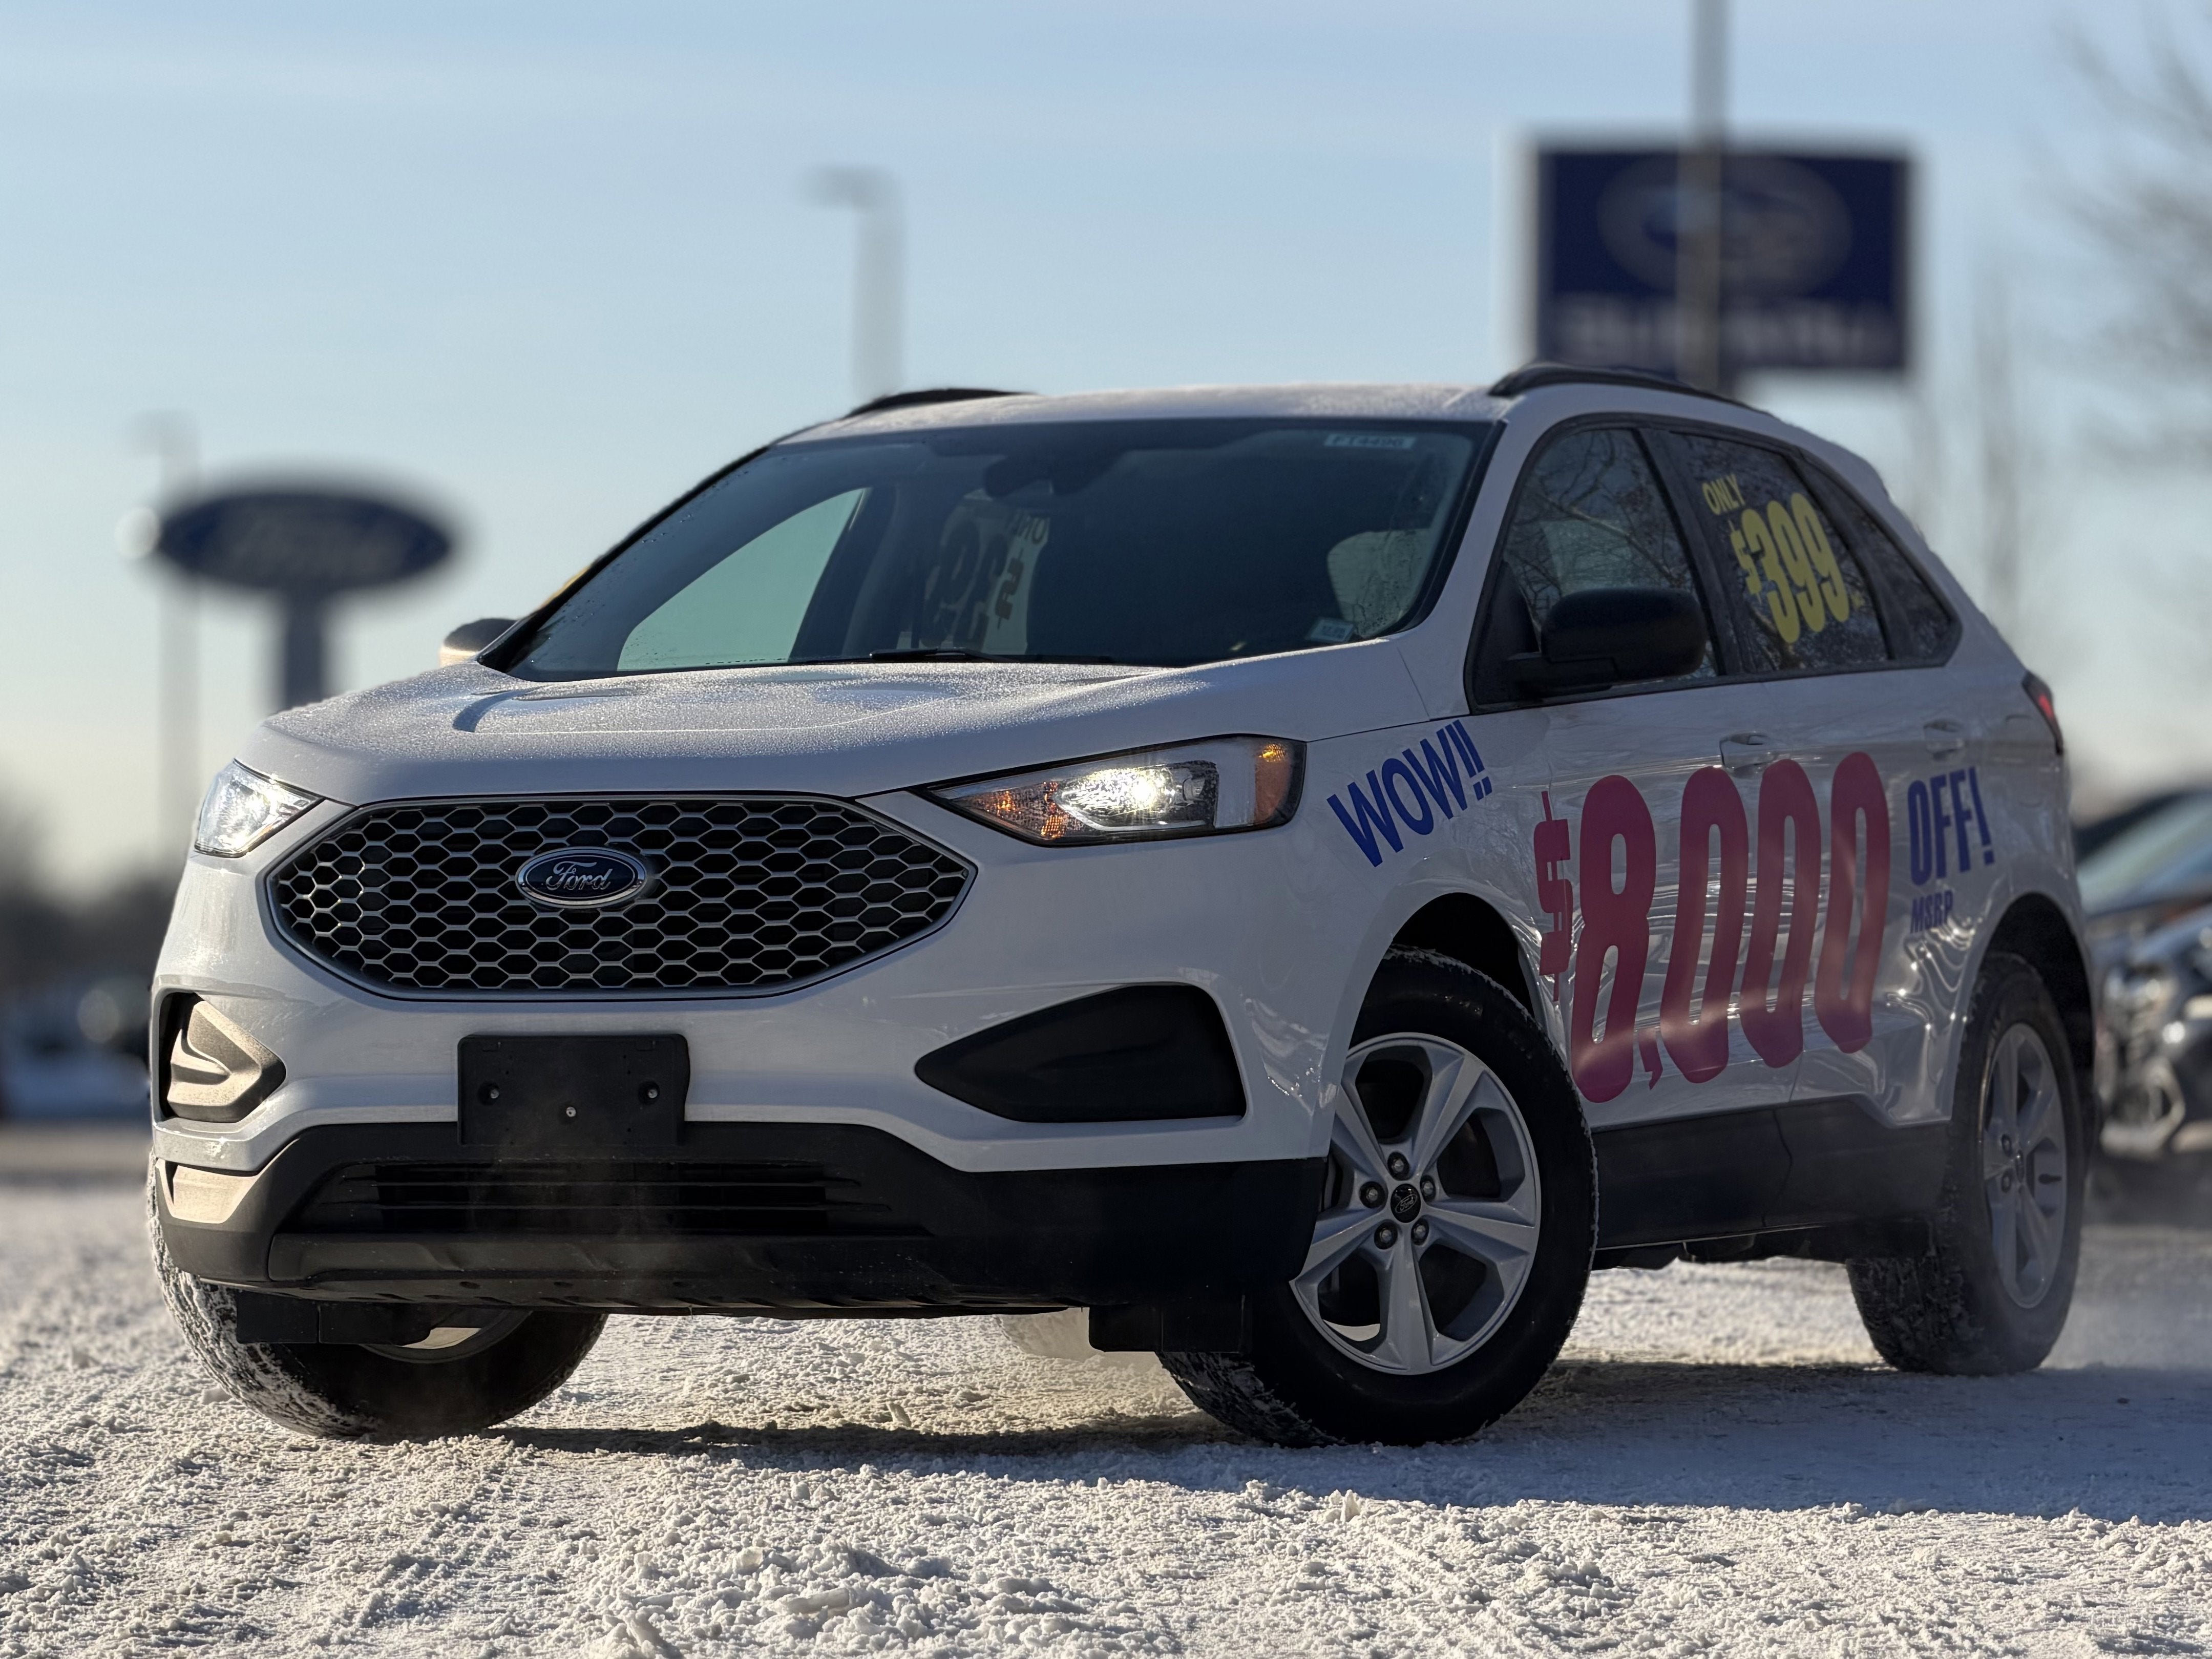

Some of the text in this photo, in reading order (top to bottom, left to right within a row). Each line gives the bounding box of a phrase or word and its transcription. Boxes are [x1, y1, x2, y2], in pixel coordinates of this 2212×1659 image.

[1702, 473, 1745, 515] ONLY
[1728, 493, 1849, 643] $399
[1326, 720, 1492, 867] WOW!!
[1908, 767, 1994, 886] OFF!
[545, 861, 613, 890] Ford
[1533, 752, 1890, 1103] $8,000
[1910, 890, 1953, 933] MSRP
